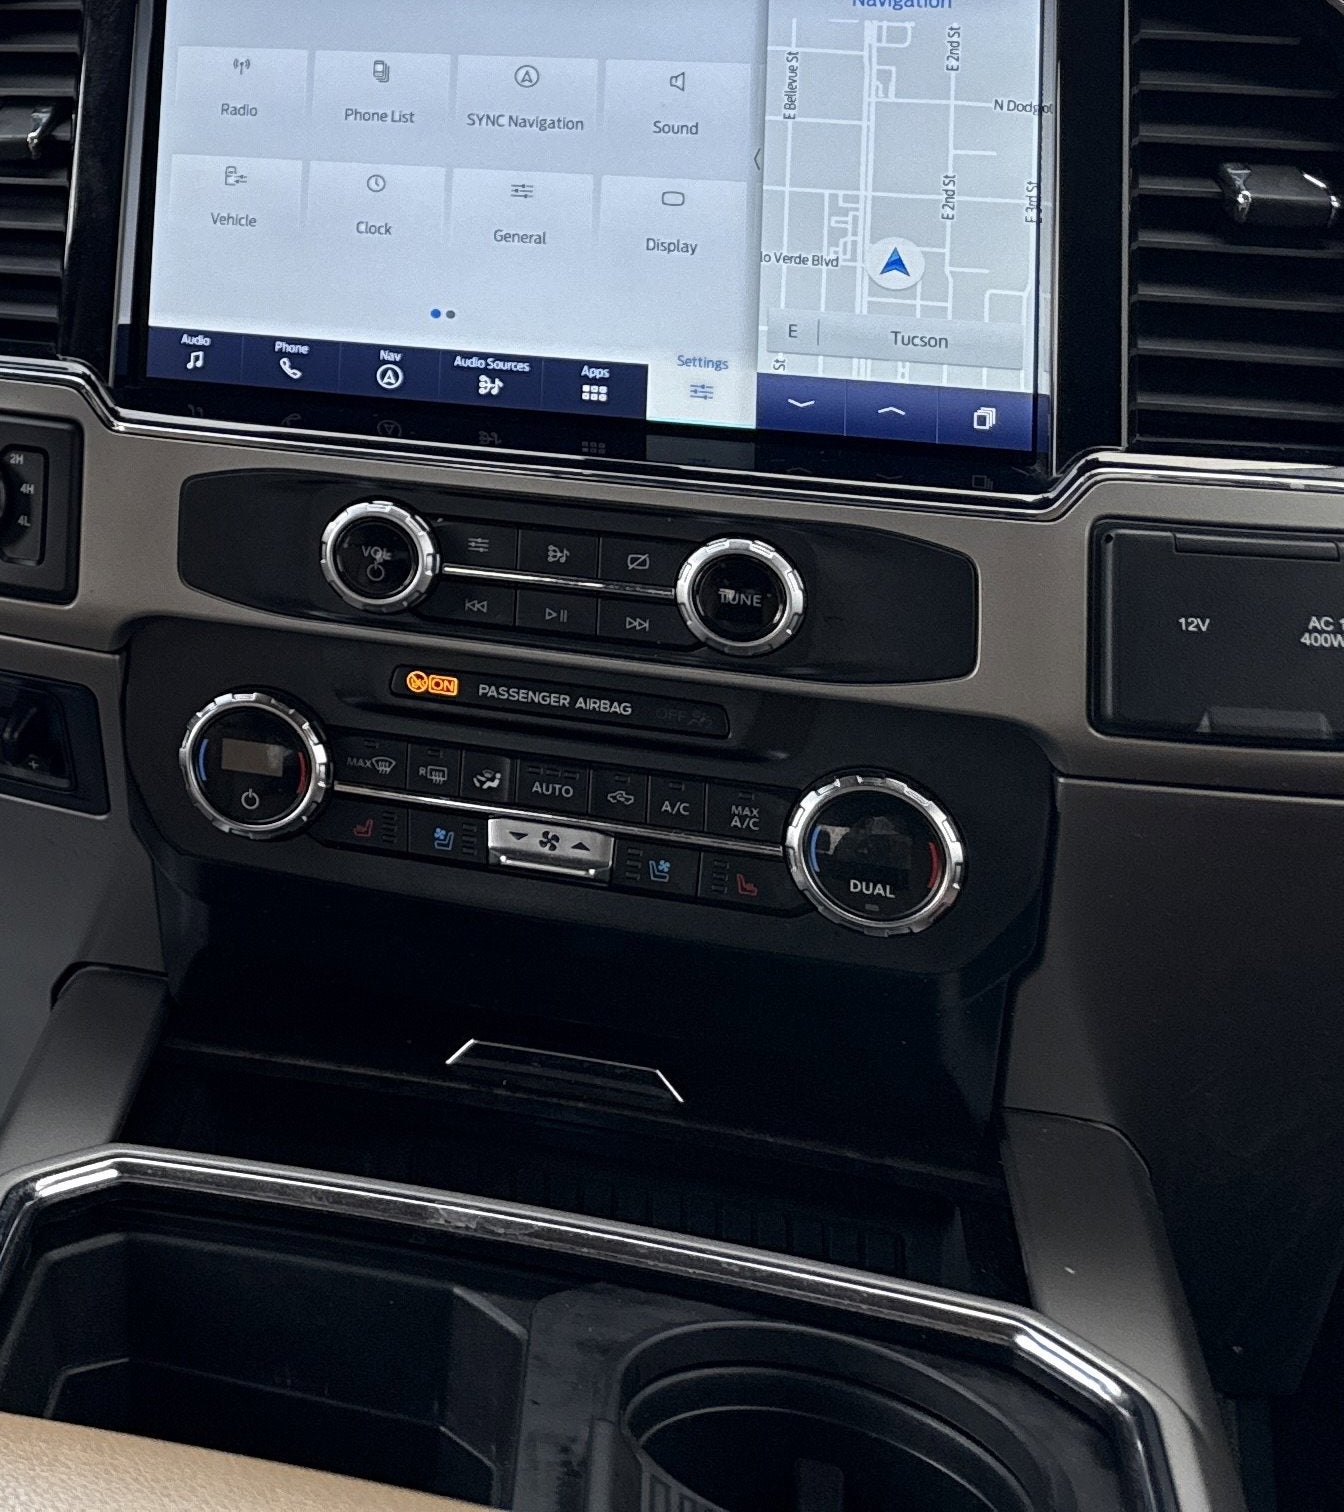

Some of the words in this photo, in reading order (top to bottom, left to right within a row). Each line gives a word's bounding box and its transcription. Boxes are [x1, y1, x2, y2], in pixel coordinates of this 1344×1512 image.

[947, 26, 961, 38] St
[786, 51, 800, 63] St
[946, 40, 960, 62] 2nd
[945, 63, 959, 72] E
[784, 68, 799, 110] Bellevue
[220, 103, 258, 117] Radio
[993, 99, 1003, 111] N
[344, 108, 388, 123] Phone
[391, 110, 415, 124] List
[466, 113, 505, 128] SYNC
[508, 114, 584, 132] Navigation
[783, 112, 796, 120] E
[652, 120, 699, 136] Sound
[943, 174, 957, 187] St
[942, 189, 956, 211] 2nd
[211, 212, 257, 228] Vehicle
[941, 212, 955, 221] E
[356, 220, 392, 236] Clock
[493, 228, 547, 245] General
[645, 238, 698, 256] Display
[774, 252, 809, 266] Verde
[812, 254, 840, 268] Blvd
[180, 333, 210, 347] Audio
[788, 324, 798, 338] E
[890, 330, 949, 349] Tucson
[274, 340, 309, 356] Phone
[380, 349, 401, 363] Nav
[453, 354, 484, 369] Audio
[486, 356, 530, 373] Sources
[676, 354, 729, 371] Settings
[581, 364, 610, 380] Apps
[772, 358, 786, 371] St
[9, 453, 24, 465] 2H
[20, 483, 34, 495] 4H
[17, 515, 31, 527] 4L
[361, 545, 392, 560] VOL
[718, 589, 762, 608] TUNE
[1178, 617, 1210, 632] 12V
[1308, 616, 1334, 631] AC
[431, 678, 454, 692] ON
[478, 683, 570, 708] PASSENGER
[575, 696, 632, 716] AIRBAG
[656, 707, 687, 722] OFF
[347, 756, 371, 768] MAX
[419, 767, 426, 777] R
[532, 782, 574, 799] AUTO
[661, 800, 690, 816] A/C
[730, 805, 759, 819] MAX
[730, 817, 760, 831] A/C
[849, 880, 895, 899] DUAL
